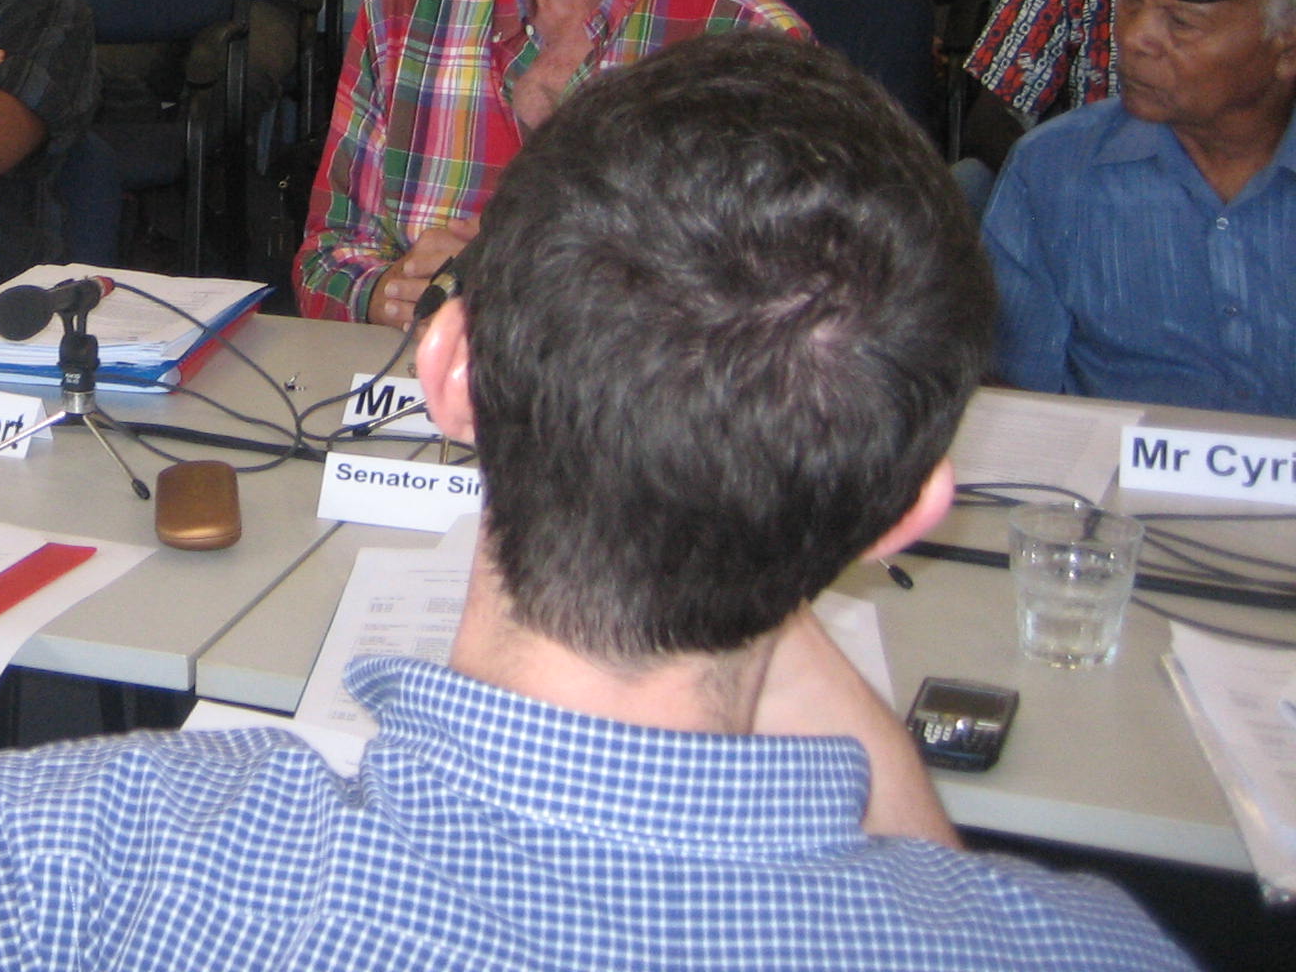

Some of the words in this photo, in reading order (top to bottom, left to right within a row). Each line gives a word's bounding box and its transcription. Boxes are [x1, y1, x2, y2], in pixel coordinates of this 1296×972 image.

[354, 383, 416, 419] Mr
[335, 462, 440, 491] Senator
[1132, 437, 1191, 472] Mr
[1206, 444, 1296, 488] Cyri
